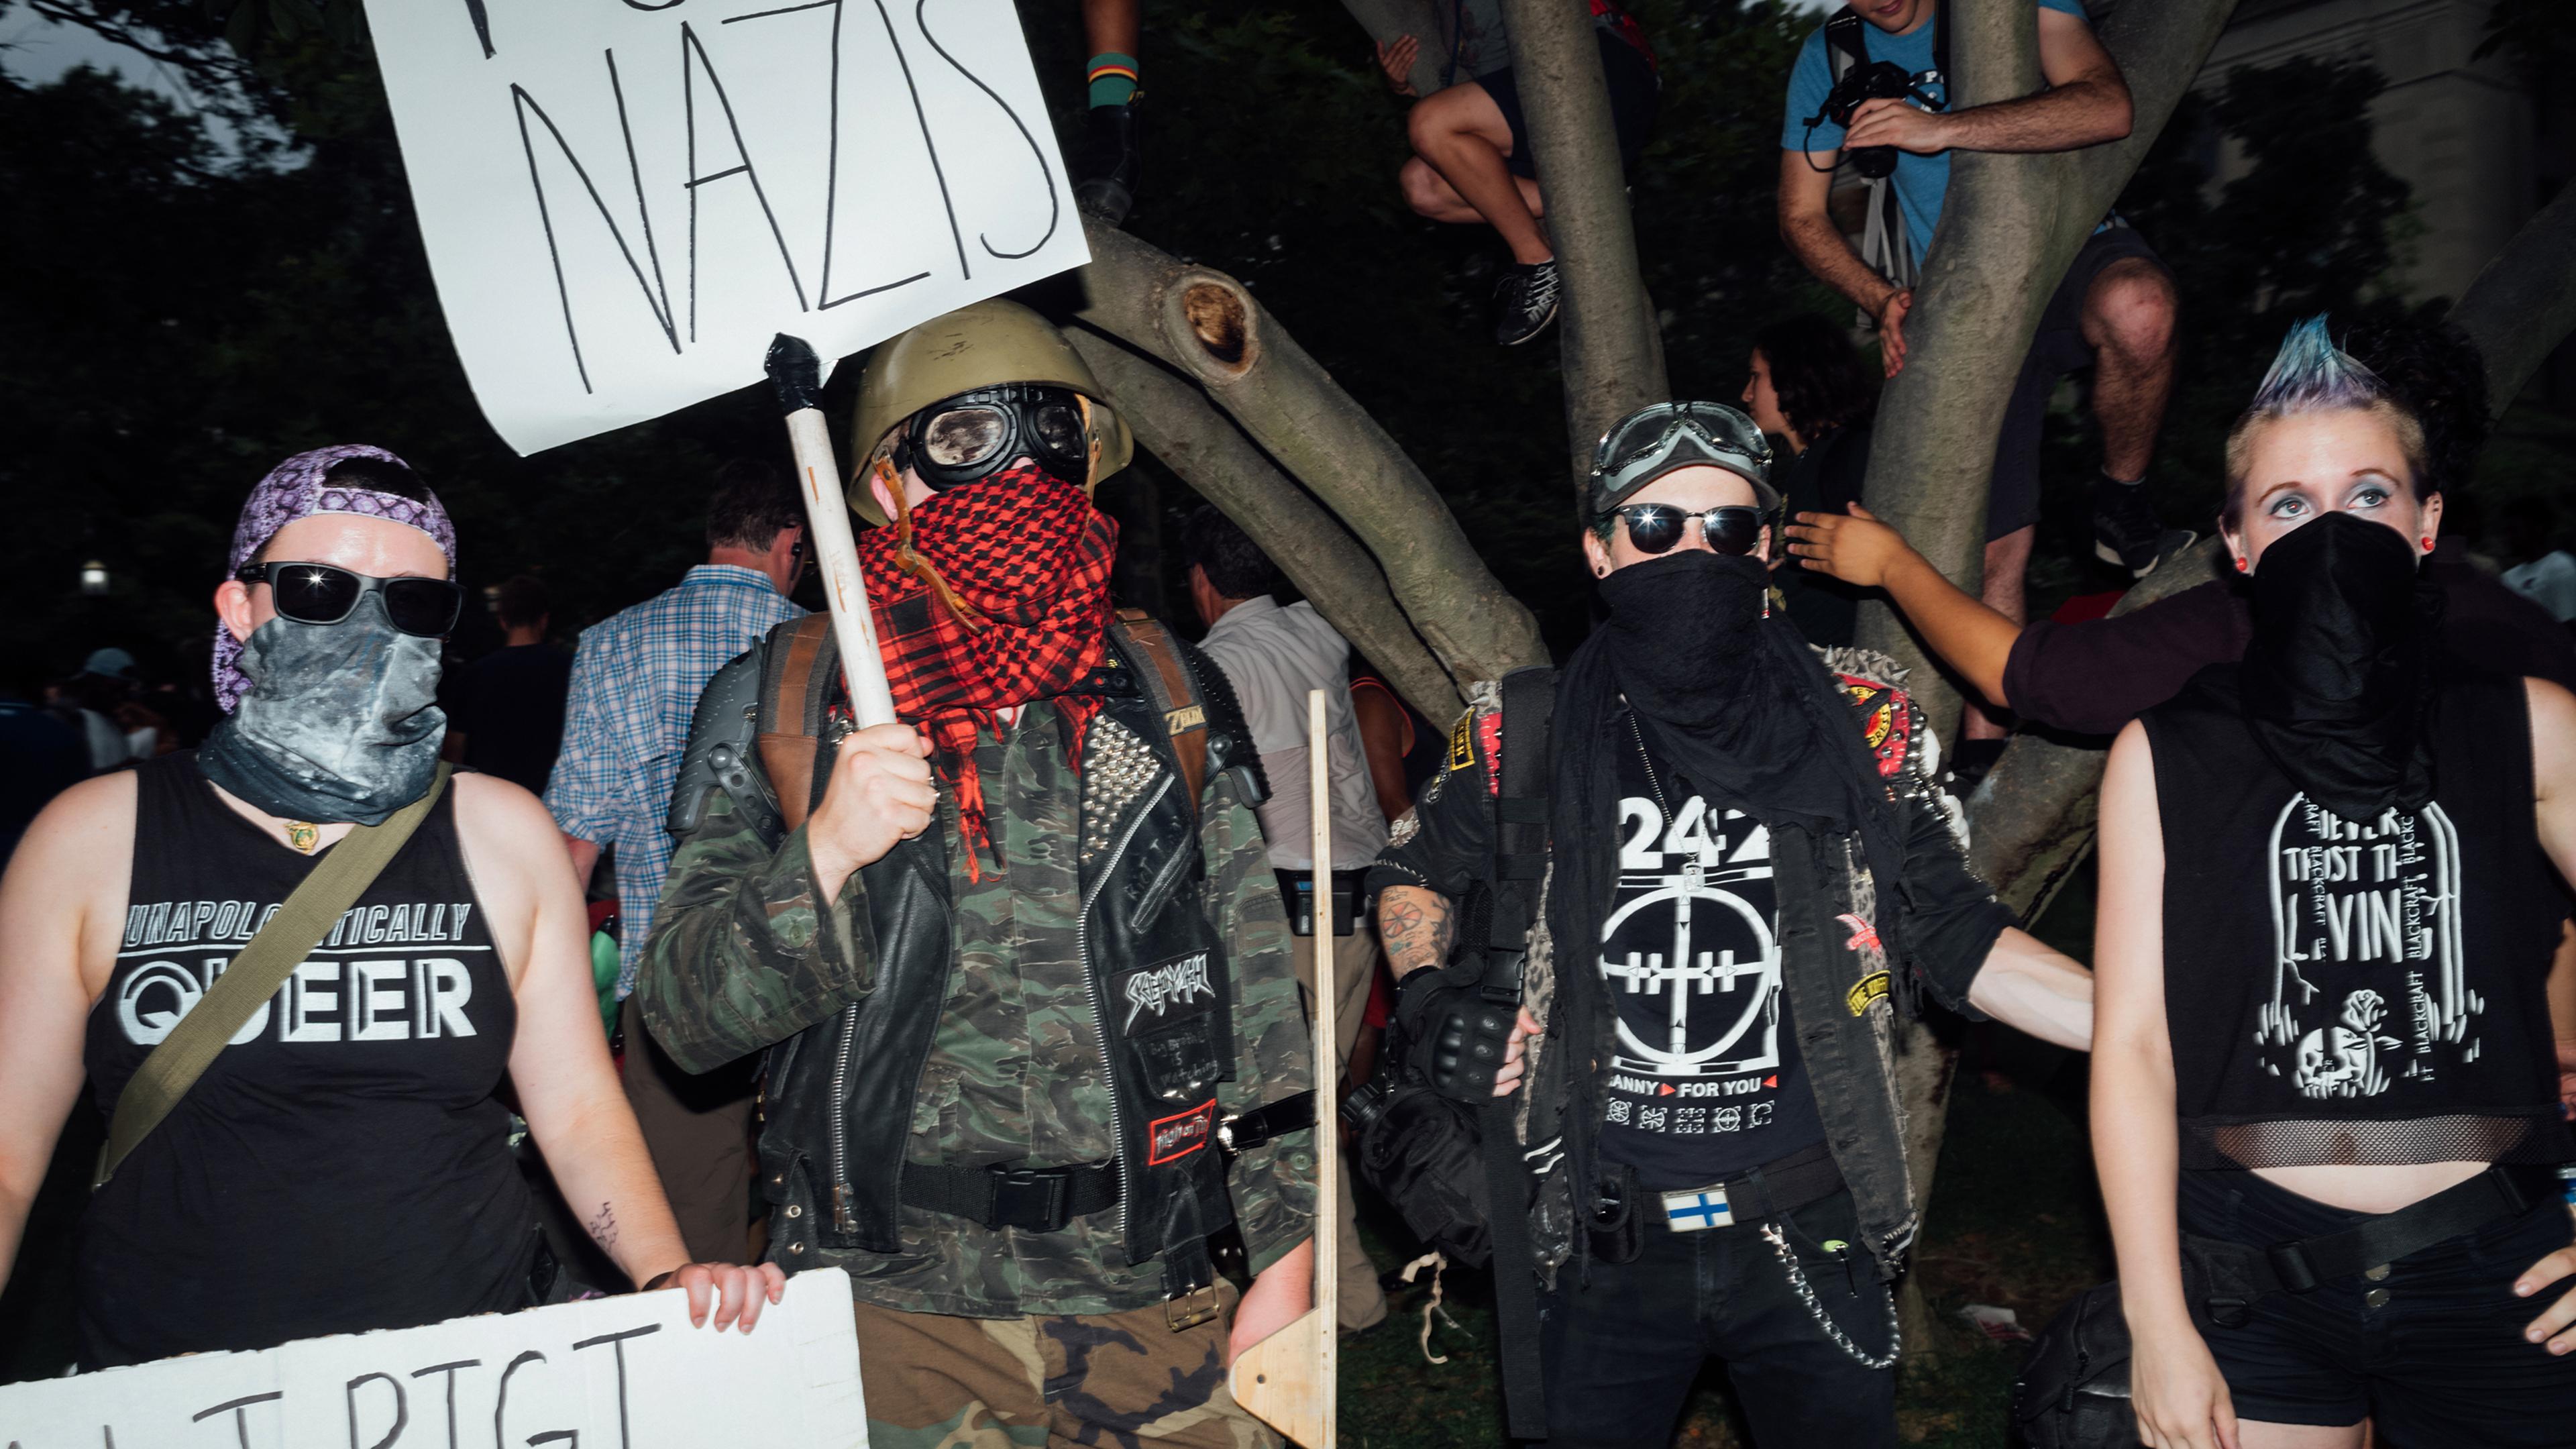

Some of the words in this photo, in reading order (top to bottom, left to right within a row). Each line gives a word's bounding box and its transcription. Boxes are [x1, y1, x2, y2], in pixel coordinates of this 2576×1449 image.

[511, 0, 1058, 394] NAZIS
[125, 900, 472, 947] UNAPOLTICALLY
[2402, 875, 2422, 959] BLACKCRAFT
[2407, 971, 2432, 1054] BLACKCRAFT
[1610, 1074, 1659, 1095] ANNY
[1676, 1081, 1720, 1098] FOR
[1721, 1077, 1762, 1097] YOU
